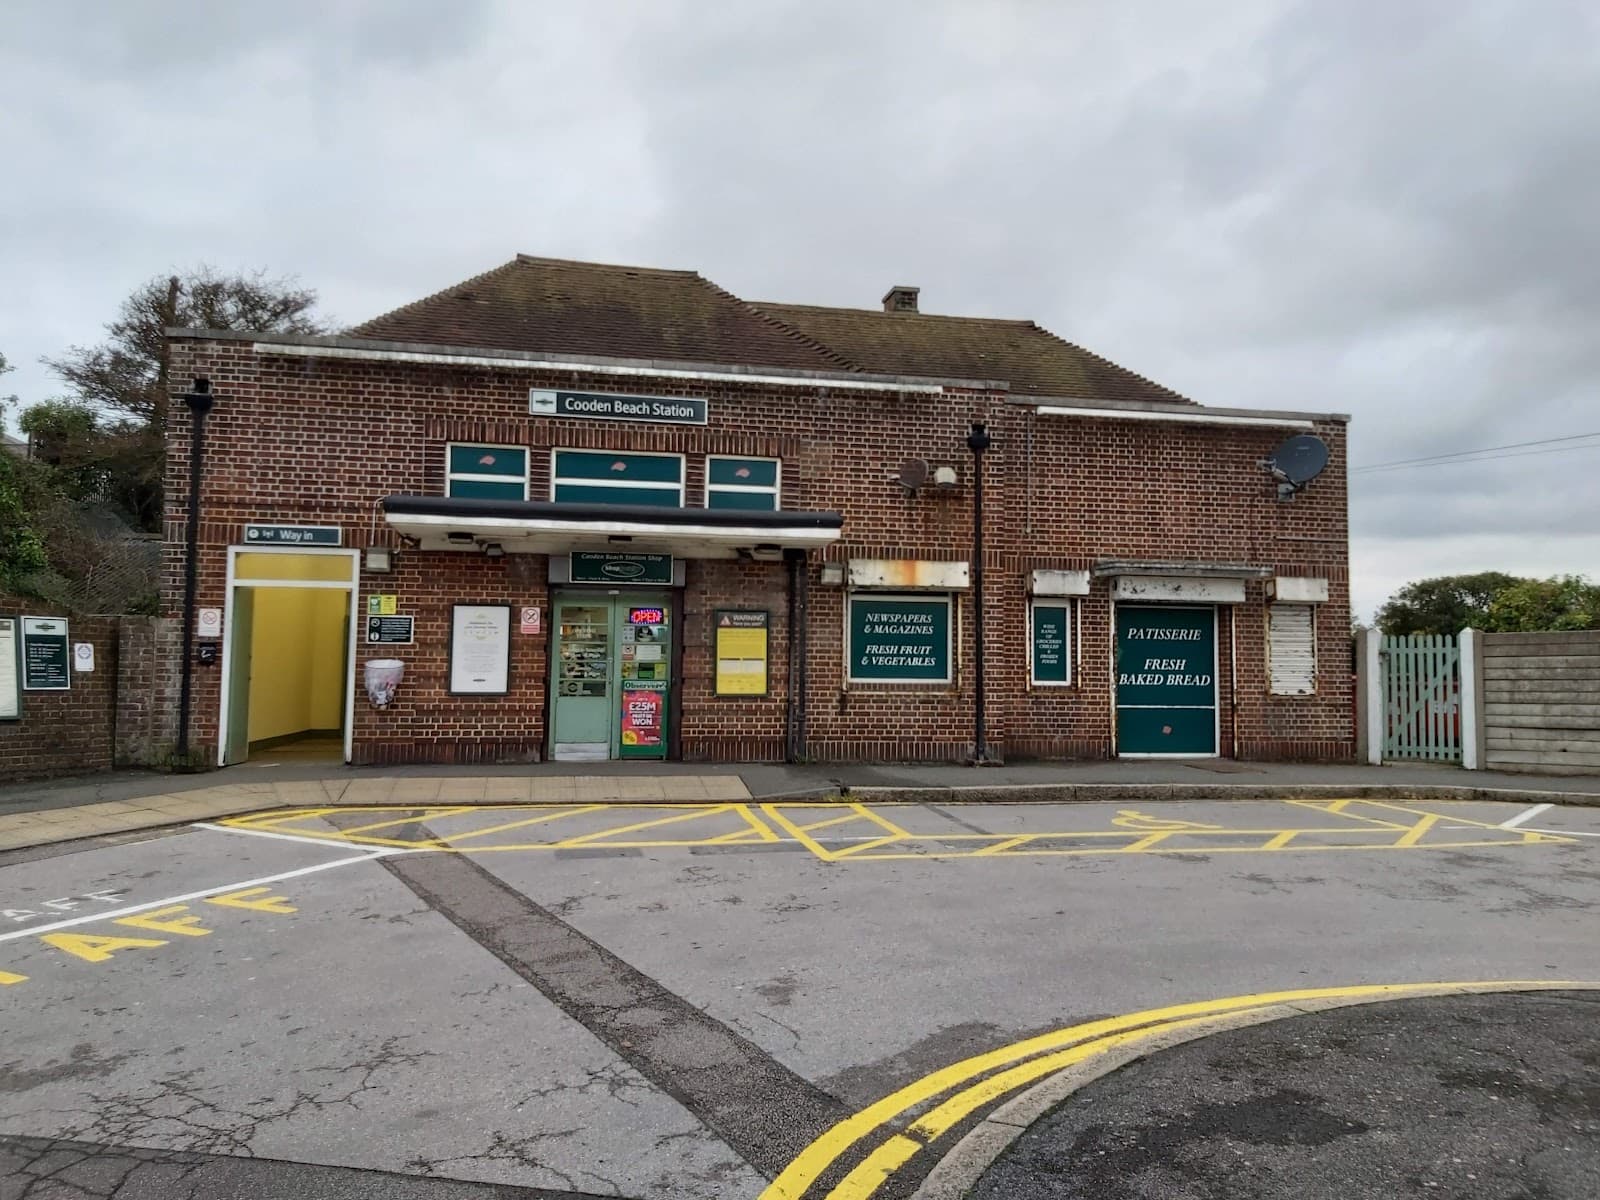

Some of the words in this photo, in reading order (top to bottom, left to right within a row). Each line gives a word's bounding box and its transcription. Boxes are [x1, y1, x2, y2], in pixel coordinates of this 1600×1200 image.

[565, 397, 611, 412] Cooden
[614, 400, 650, 415] Beach
[652, 403, 694, 418] Station
[279, 529, 302, 542] Way
[303, 530, 313, 540] in
[632, 611, 661, 622] OPEN
[733, 614, 764, 622] WARNING
[865, 613, 933, 623] NEWSPAPERS
[864, 625, 871, 633] &
[873, 625, 934, 635] MAGAZINES
[1128, 628, 1202, 640] PATISSERIE
[865, 645, 899, 654] FRESH
[900, 645, 932, 655] FRUIT
[861, 656, 869, 665] &
[871, 656, 936, 666] VEGETABLES
[1144, 658, 1187, 670] FRESH
[1119, 673, 1164, 685] BAKED
[1166, 674, 1211, 686] BREAD
[629, 702, 656, 711] £25M
[632, 718, 653, 726] WON
